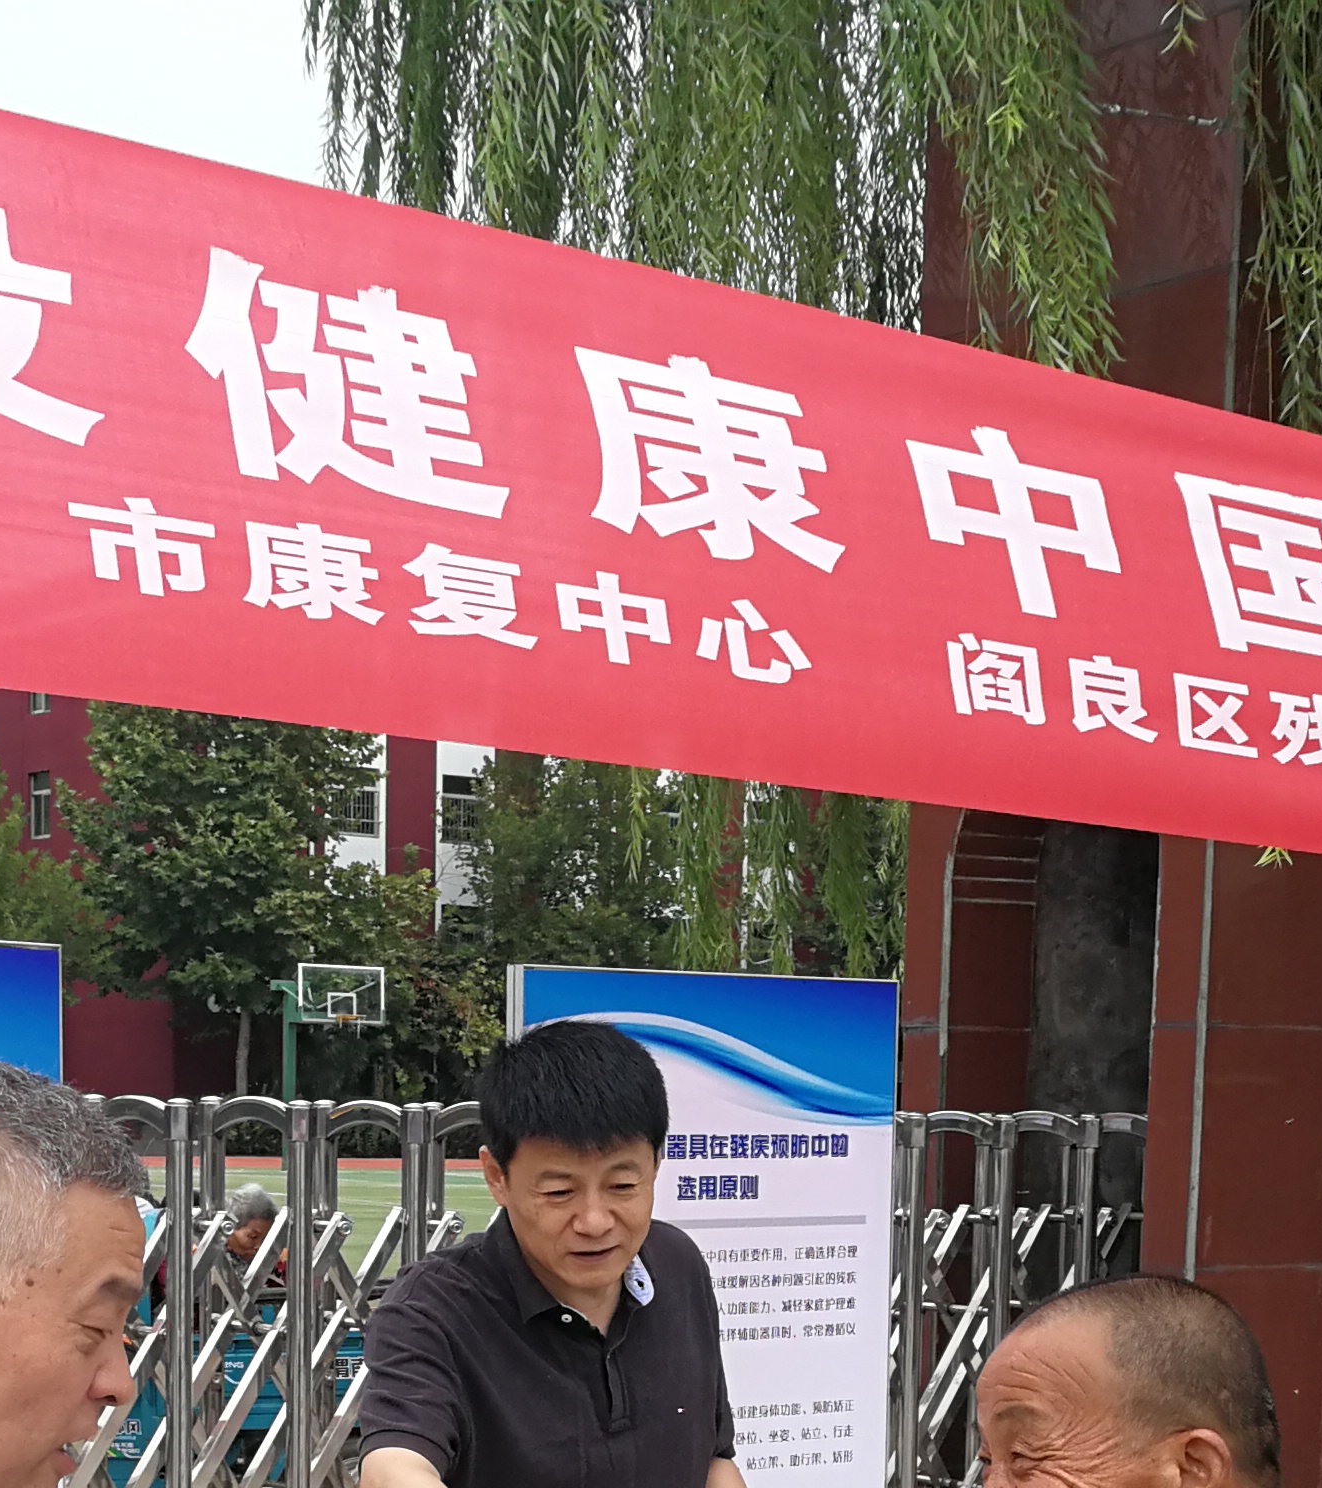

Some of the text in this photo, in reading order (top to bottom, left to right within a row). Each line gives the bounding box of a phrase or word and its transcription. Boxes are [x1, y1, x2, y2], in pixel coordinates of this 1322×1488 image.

[68, 496, 813, 688] 市康复中心
[660, 1133, 849, 1160] 器具在残疾预防中的
[677, 1174, 759, 1201] 选用原则
